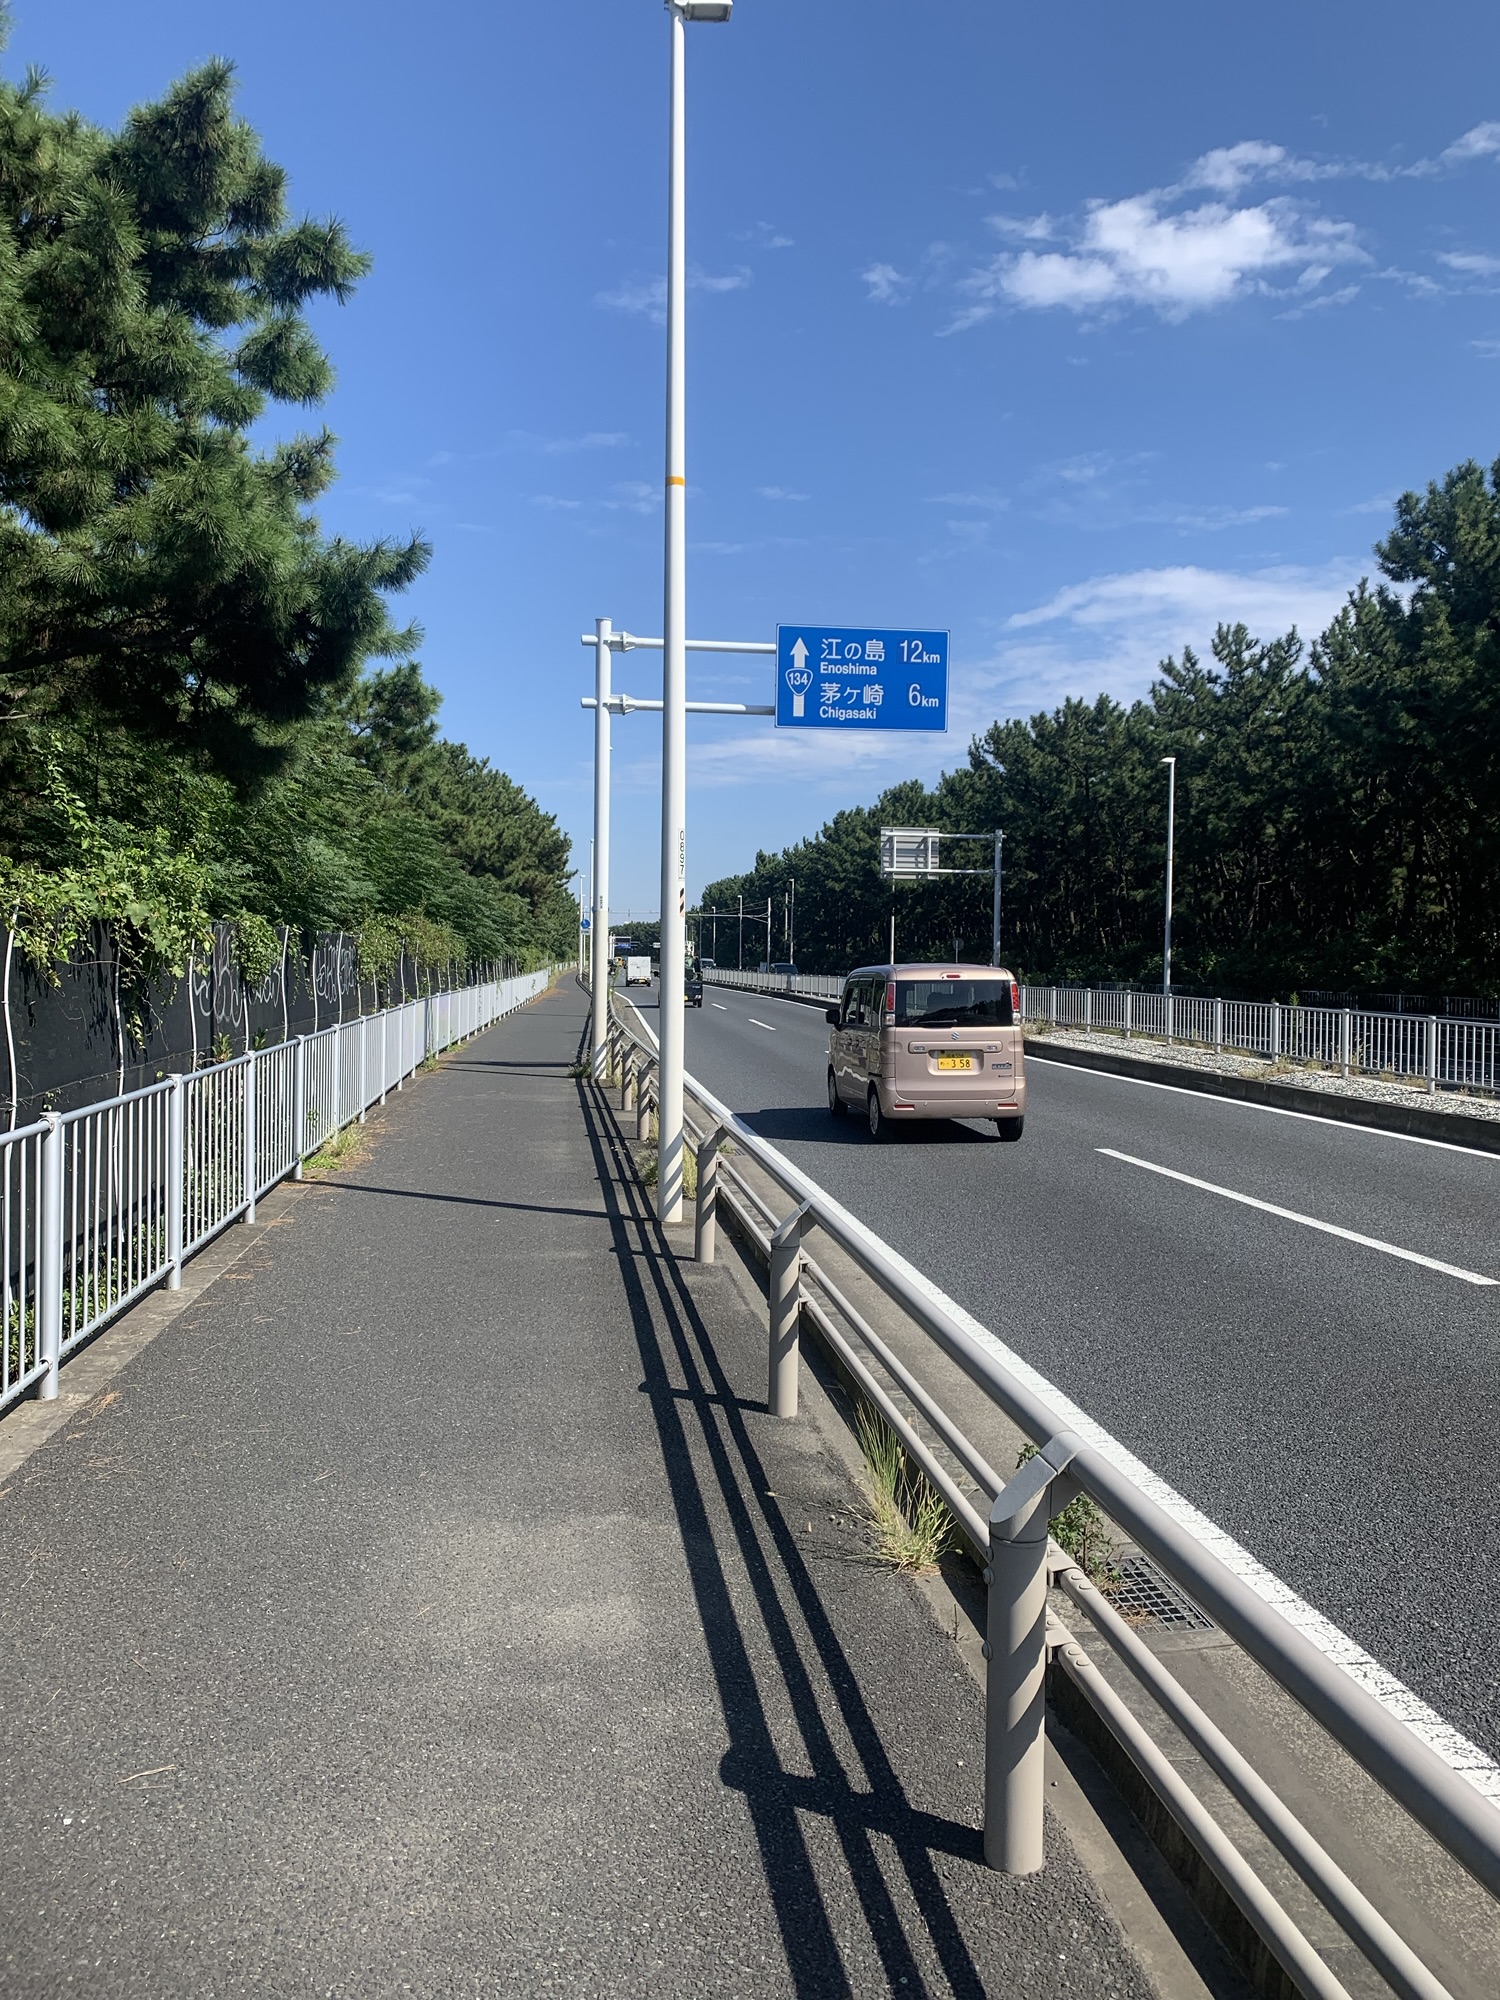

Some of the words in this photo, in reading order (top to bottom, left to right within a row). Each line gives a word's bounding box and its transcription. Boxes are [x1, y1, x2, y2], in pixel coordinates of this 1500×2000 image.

[820, 638, 885, 662] 江の島
[899, 640, 940, 663] 12km
[820, 662, 877, 675] Enoshima
[789, 672, 808, 686] 134
[908, 683, 939, 708] 6km
[820, 706, 877, 721] Chigasaki
